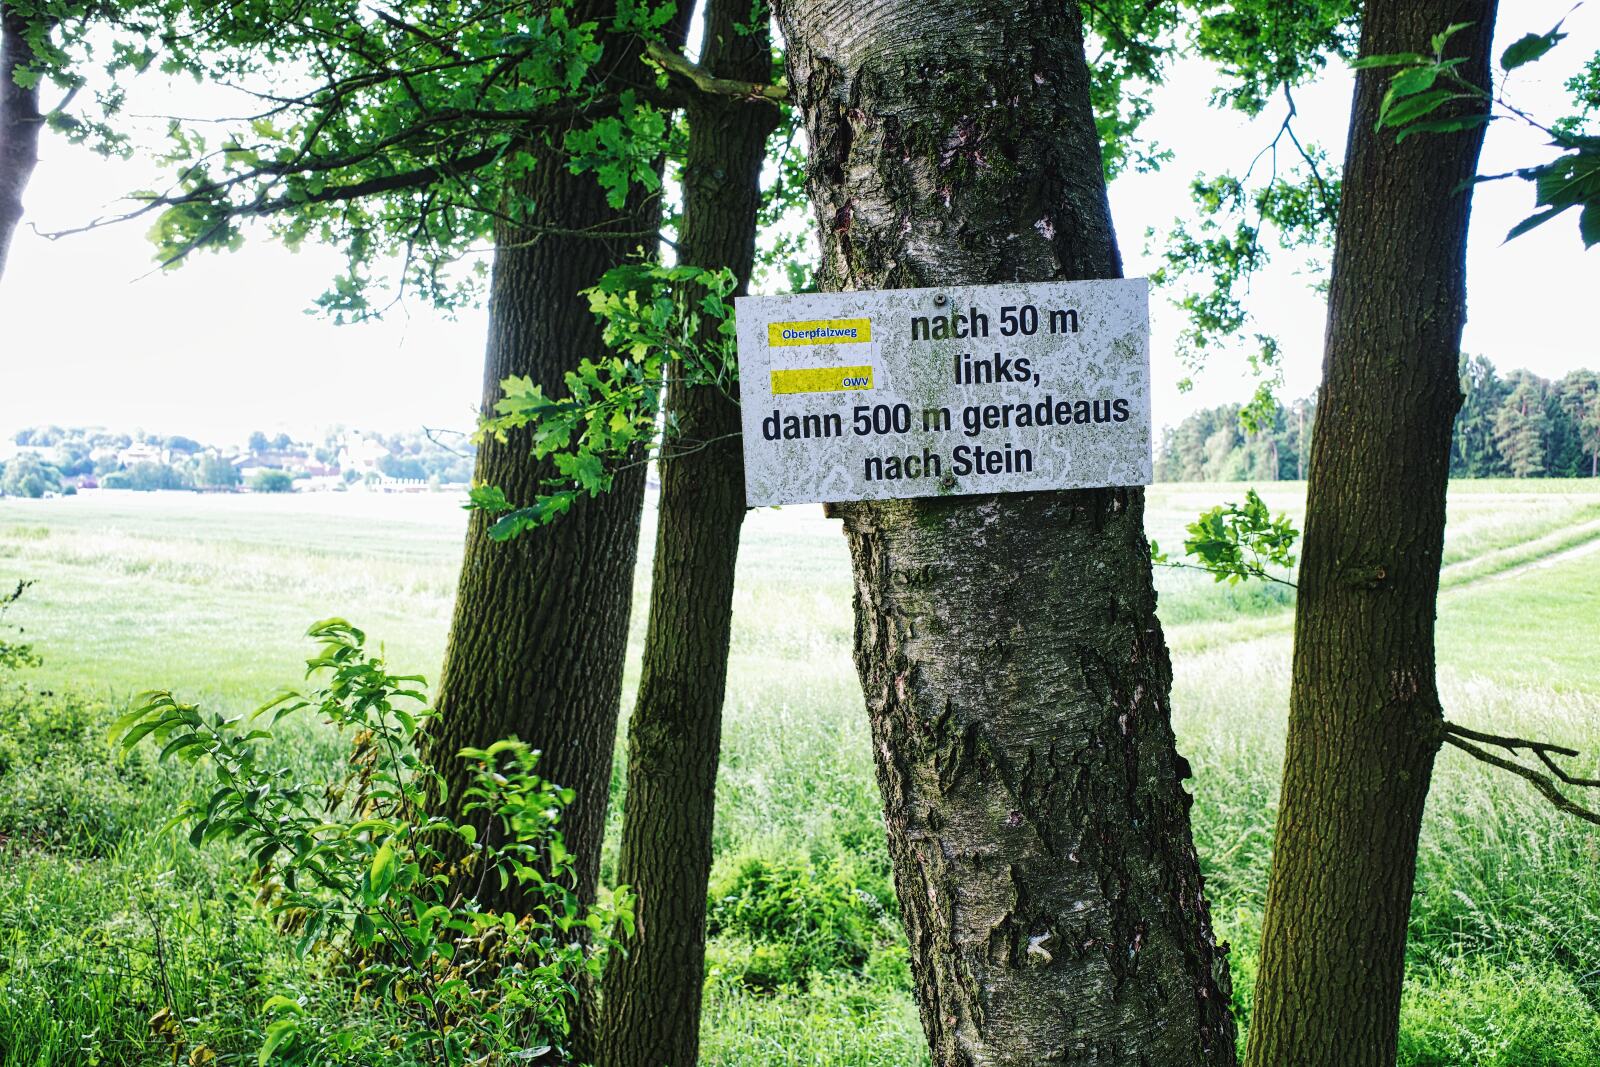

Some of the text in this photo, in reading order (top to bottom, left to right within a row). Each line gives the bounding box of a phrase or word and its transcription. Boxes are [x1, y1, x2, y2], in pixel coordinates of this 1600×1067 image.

[782, 327, 857, 339] Oberpfalzweg
[911, 305, 1078, 341] nach 50 m
[843, 376, 869, 387] OWV
[954, 353, 1040, 387] links,
[762, 395, 1130, 441] dann 500 m geradeaus
[864, 443, 1033, 481] nach Stein
